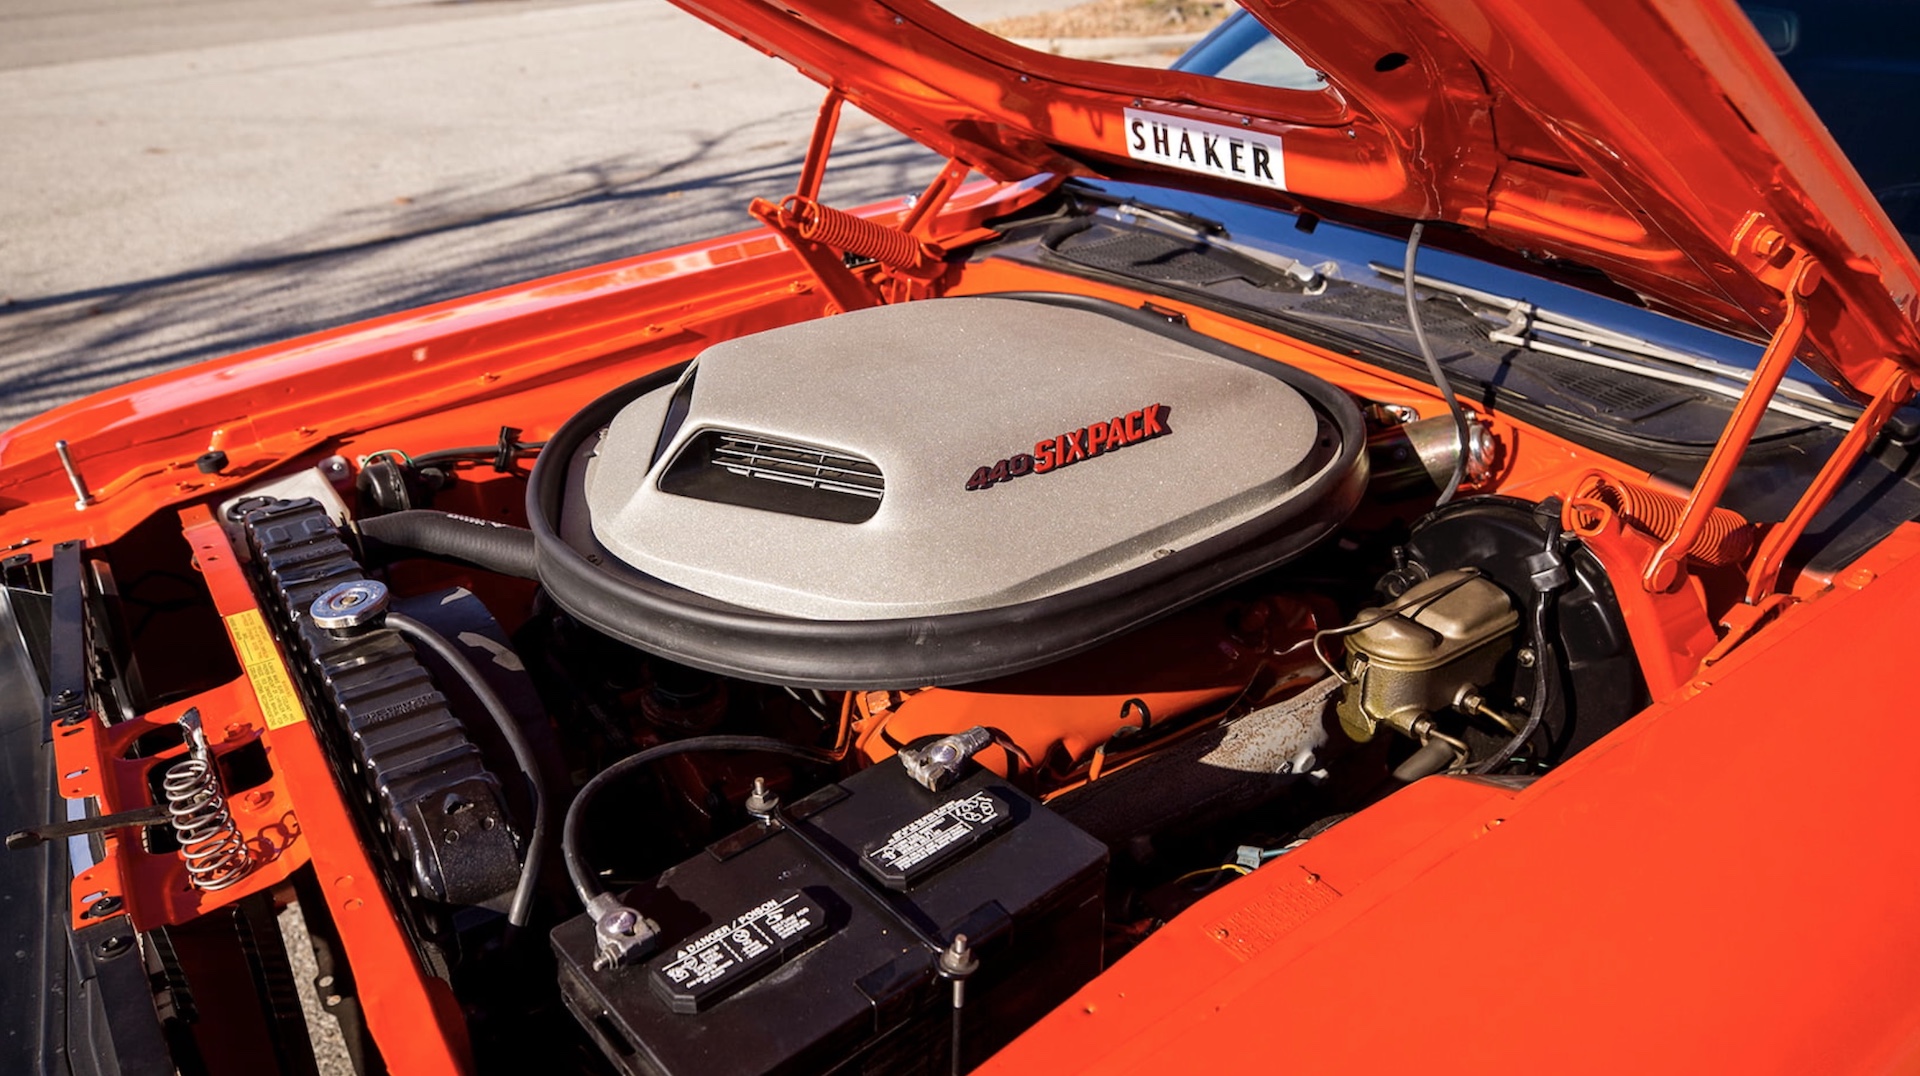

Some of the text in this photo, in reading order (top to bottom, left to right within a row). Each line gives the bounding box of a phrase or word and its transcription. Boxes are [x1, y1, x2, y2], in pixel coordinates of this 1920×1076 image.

[1132, 118, 1275, 183] SHAKER
[966, 453, 1034, 491] 440
[686, 925, 732, 952] DANGER
[737, 899, 779, 925] POISON
